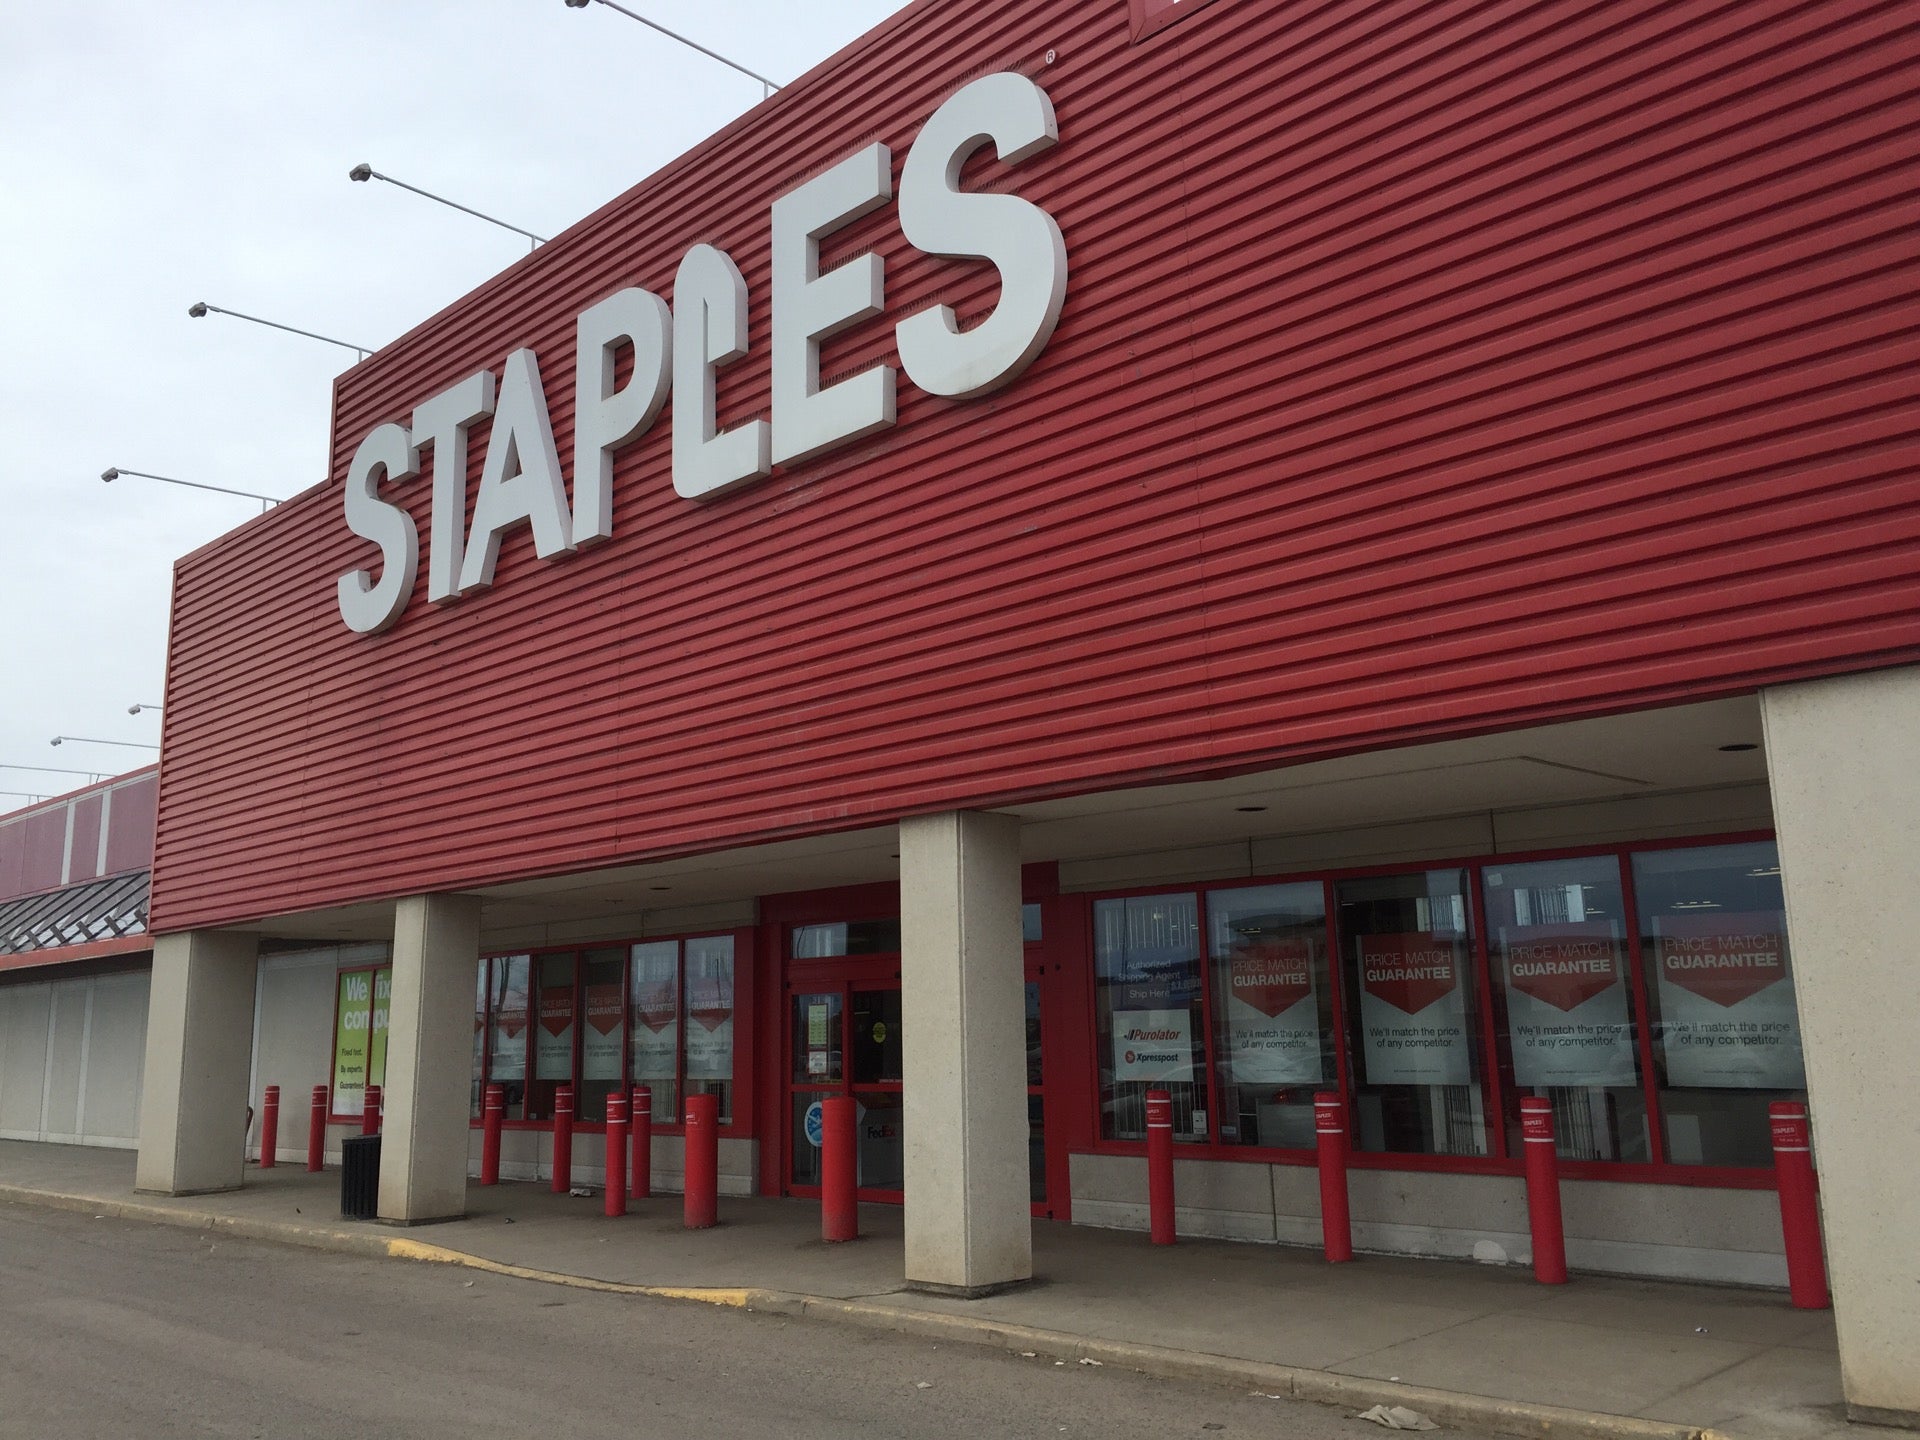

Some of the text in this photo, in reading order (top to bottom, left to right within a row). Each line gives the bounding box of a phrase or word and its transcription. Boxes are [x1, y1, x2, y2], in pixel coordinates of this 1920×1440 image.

[337, 70, 1068, 633] STAPLES
[1664, 934, 1778, 951] PRICE MATCH
[1510, 942, 1610, 960] PRICE MATCH
[1126, 959, 1171, 969] Authorized
[1232, 958, 1307, 973] PRICE MATCH
[1365, 950, 1451, 967] PRICE MATCH
[1666, 952, 1779, 969] GUARANTEE
[1366, 966, 1451, 982] GUARANTEE
[1513, 959, 1611, 976] GUARANTEE
[1155, 971, 1181, 982] Agent
[1233, 973, 1307, 987] GUARANTEE
[346, 976, 368, 1001] We
[1129, 989, 1171, 1000] Ship Here
[1133, 1029, 1182, 1041] Purolator
[1392, 1027, 1419, 1037] match
[1421, 1027, 1435, 1036] the
[1437, 1026, 1460, 1039] price
[1517, 1024, 1622, 1037] We'll match the price
[1701, 1022, 1736, 1033] match
[1739, 1022, 1758, 1033] the
[1761, 1021, 1790, 1035] price
[1376, 1038, 1386, 1048] of
[1387, 1040, 1402, 1049] any
[1526, 1037, 1536, 1047] of
[1538, 1038, 1555, 1048] any
[1680, 1034, 1692, 1045] of
[1695, 1036, 1715, 1047] any
[1136, 1053, 1178, 1064] Xpresspost
[867, 1125, 896, 1140] FedEx
